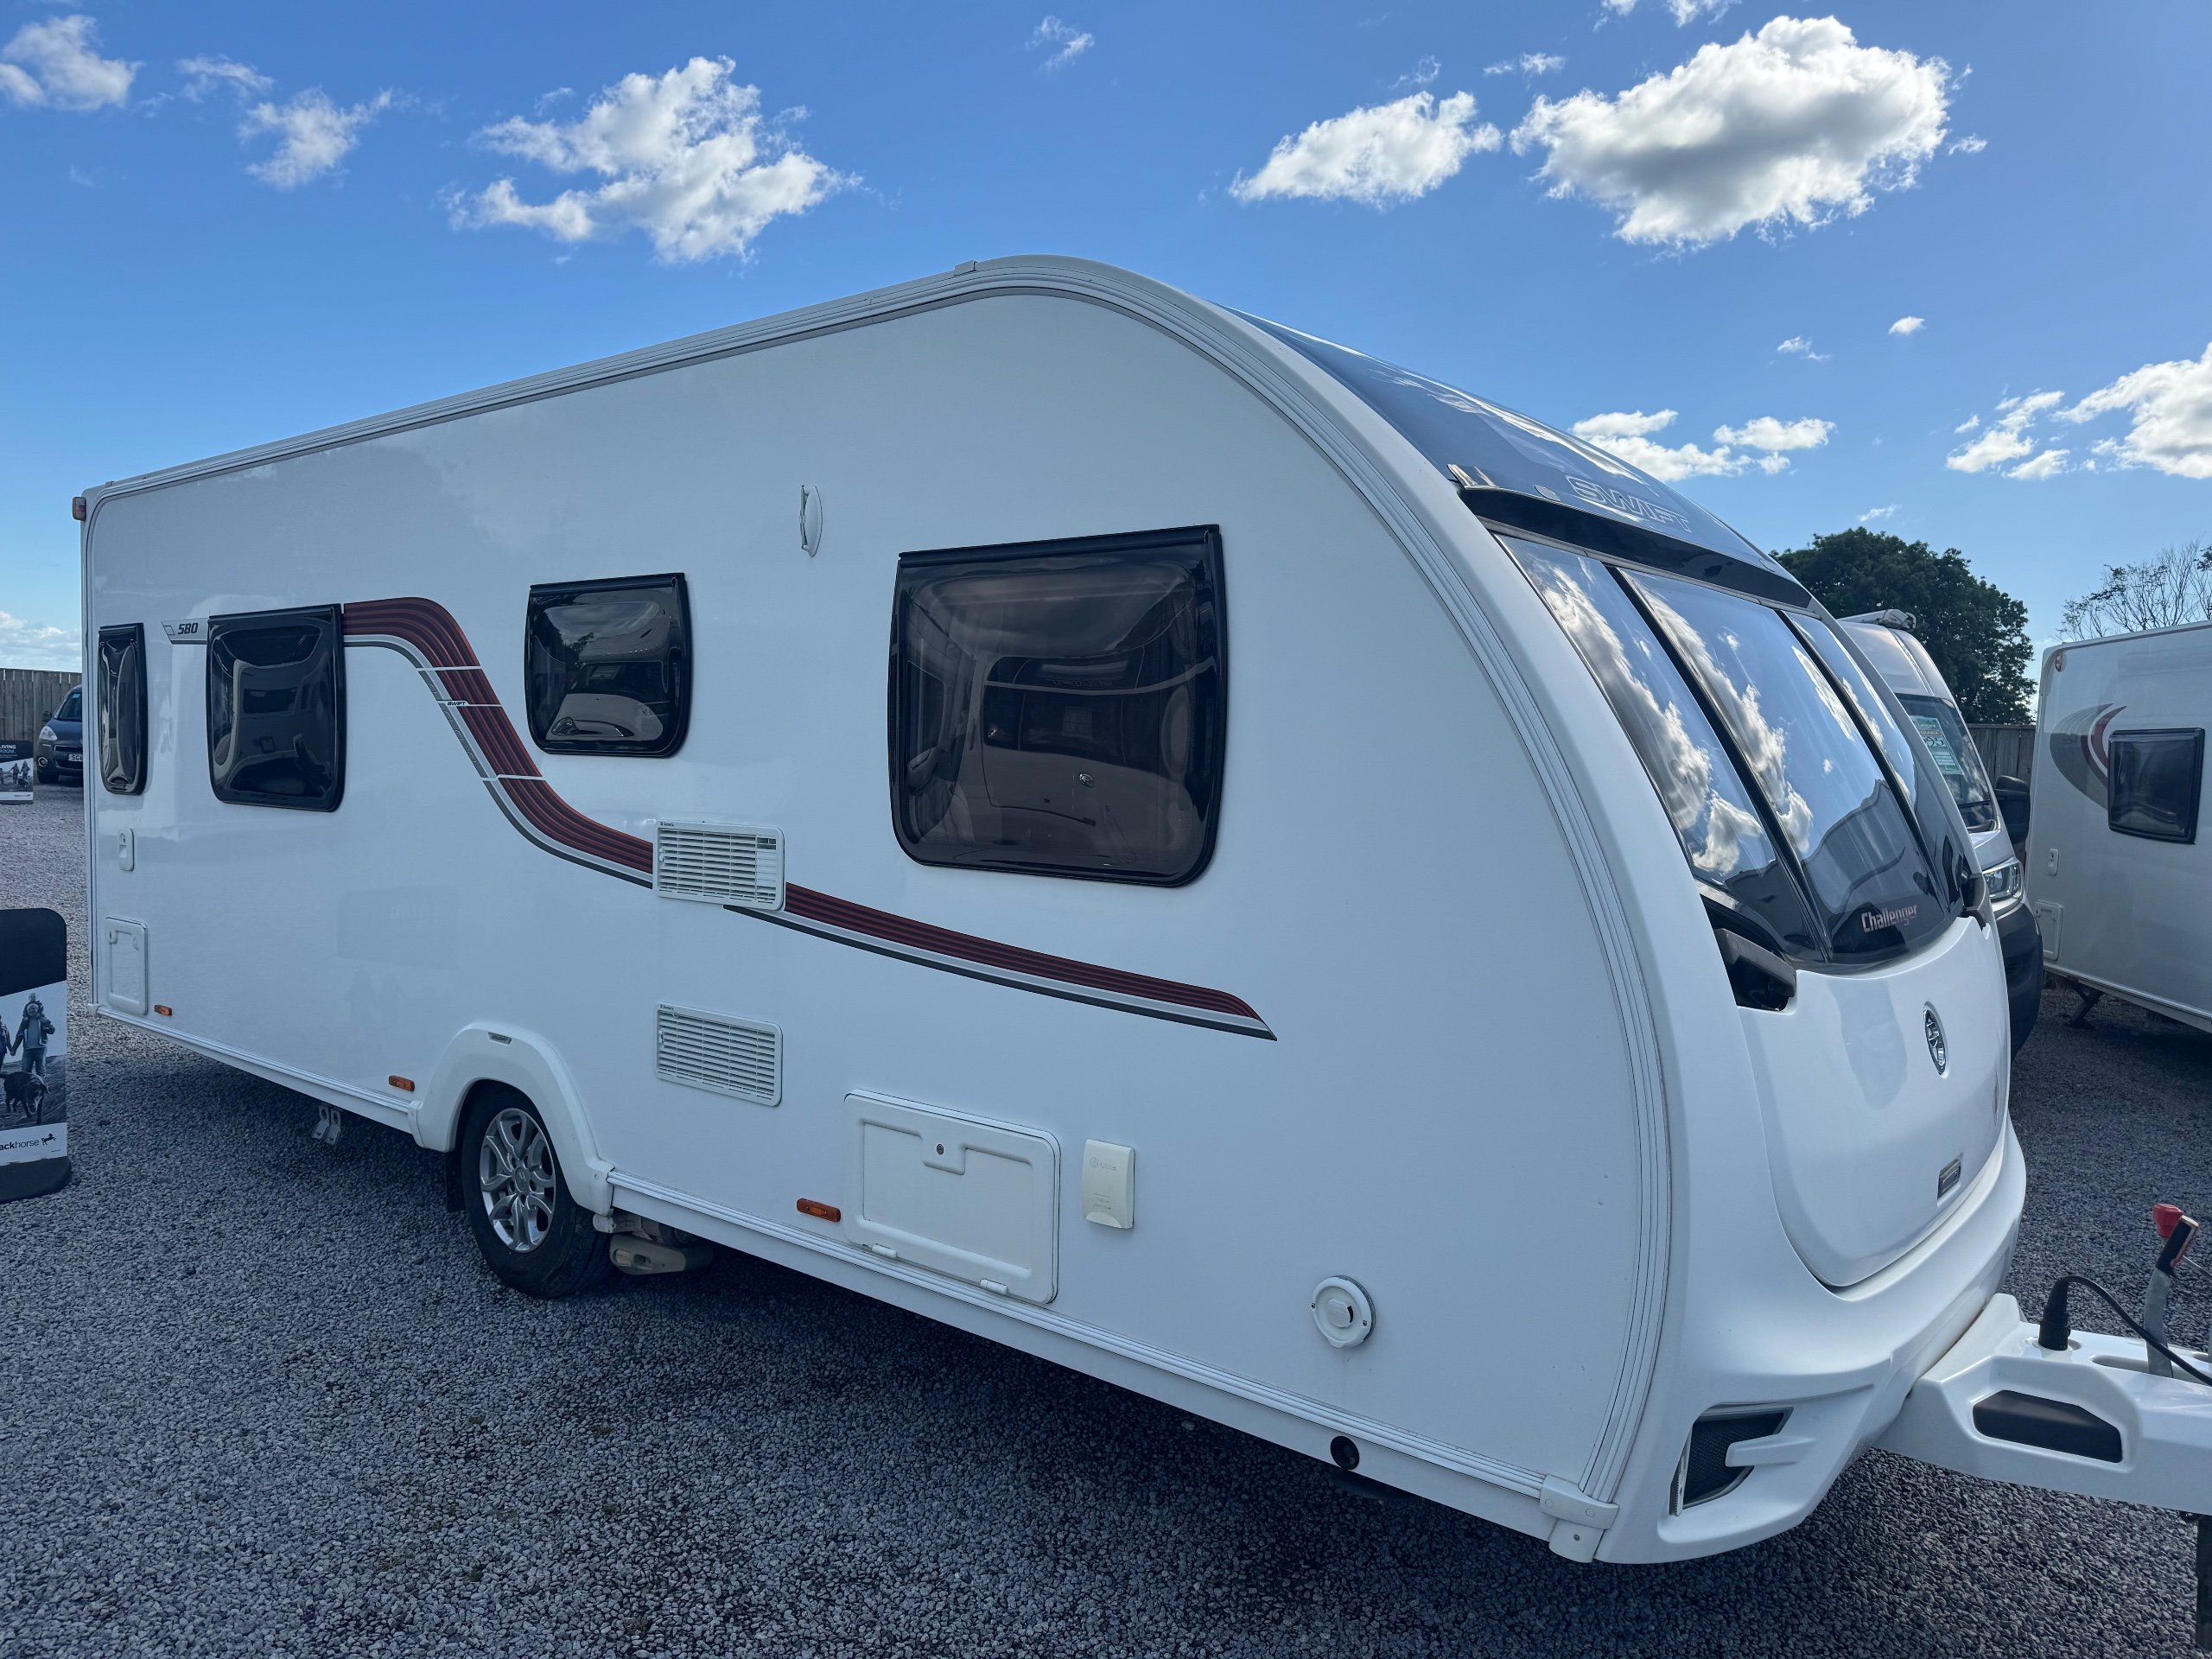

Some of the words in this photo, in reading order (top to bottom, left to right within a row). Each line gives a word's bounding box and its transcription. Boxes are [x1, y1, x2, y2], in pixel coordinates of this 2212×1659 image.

[1565, 474, 1692, 532] SWIFT
[178, 622, 199, 635] 580
[1860, 903, 1918, 933] Challenger
